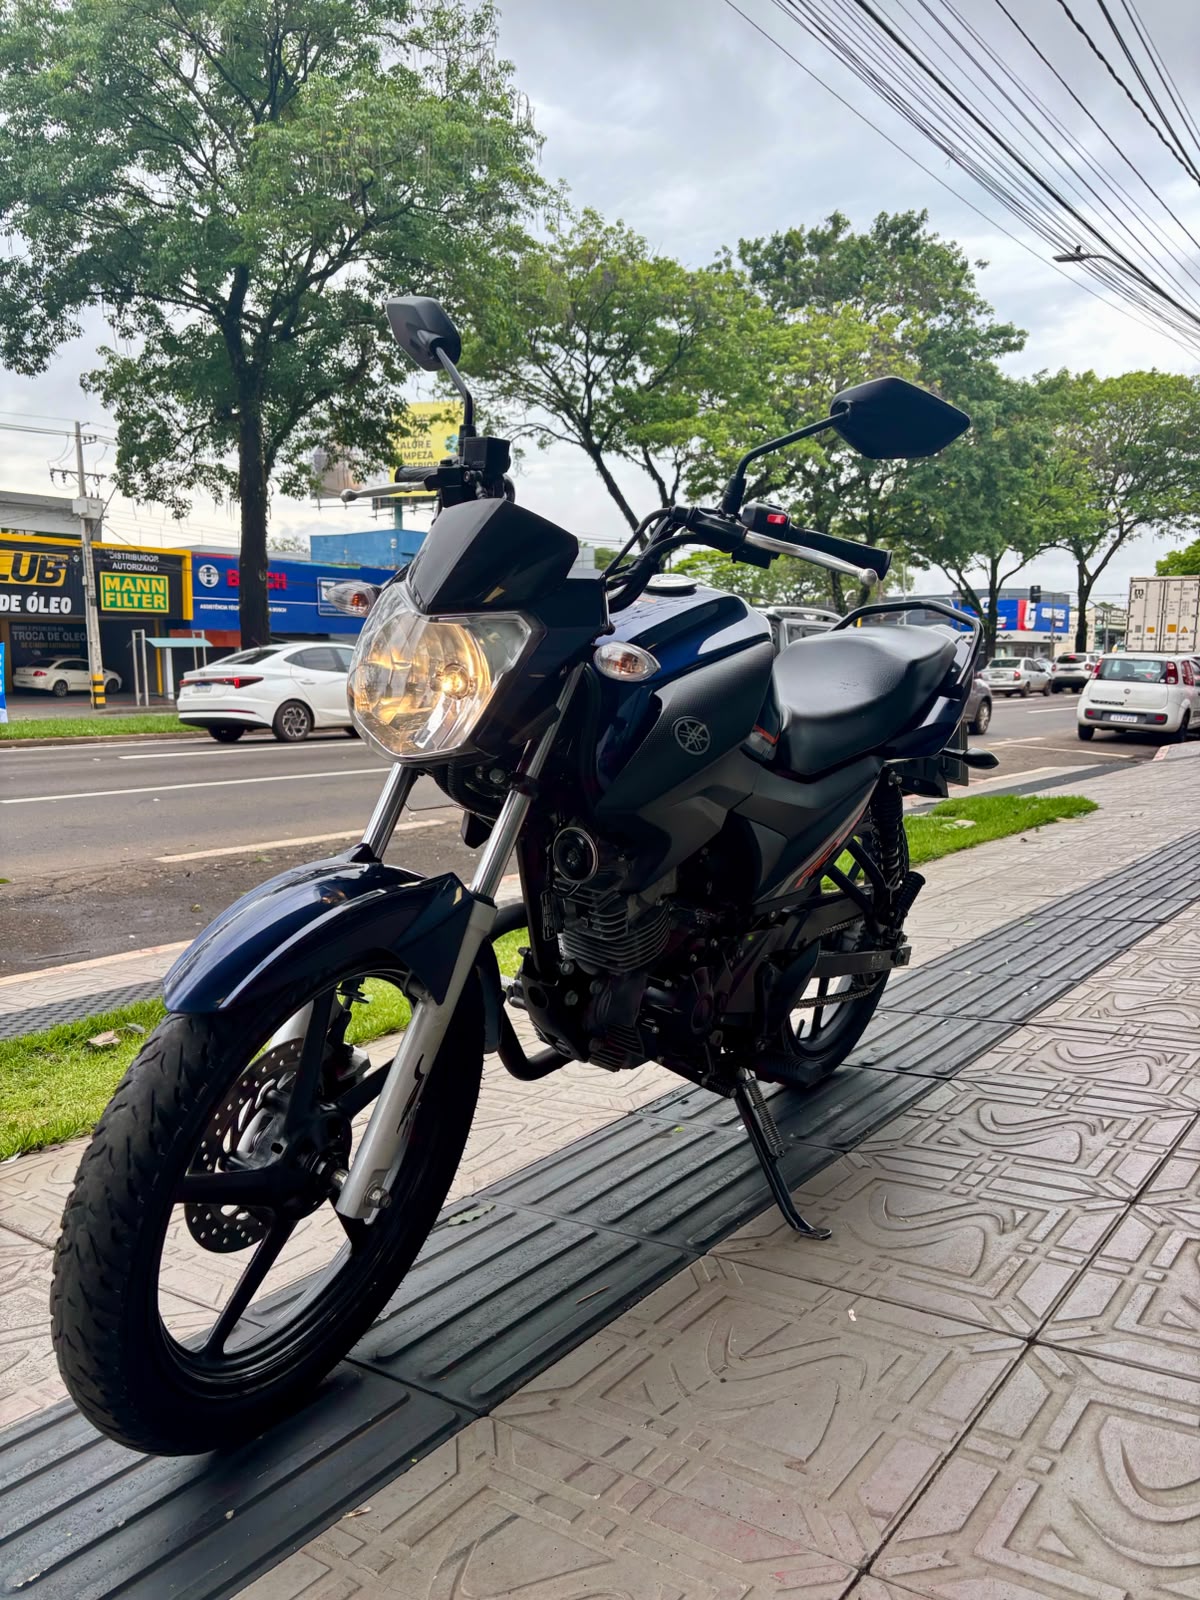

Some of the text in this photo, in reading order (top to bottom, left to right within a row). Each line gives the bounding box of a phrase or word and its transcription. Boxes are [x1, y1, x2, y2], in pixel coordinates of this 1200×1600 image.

[403, 451, 434, 460] MPEZA
[112, 562, 158, 572] AUTORIZADO
[105, 576, 165, 593] MANN
[0, 591, 72, 614] DE ÓLEO
[105, 592, 165, 609] FILTER
[12, 631, 46, 641] TROCA
[47, 632, 60, 641] DE
